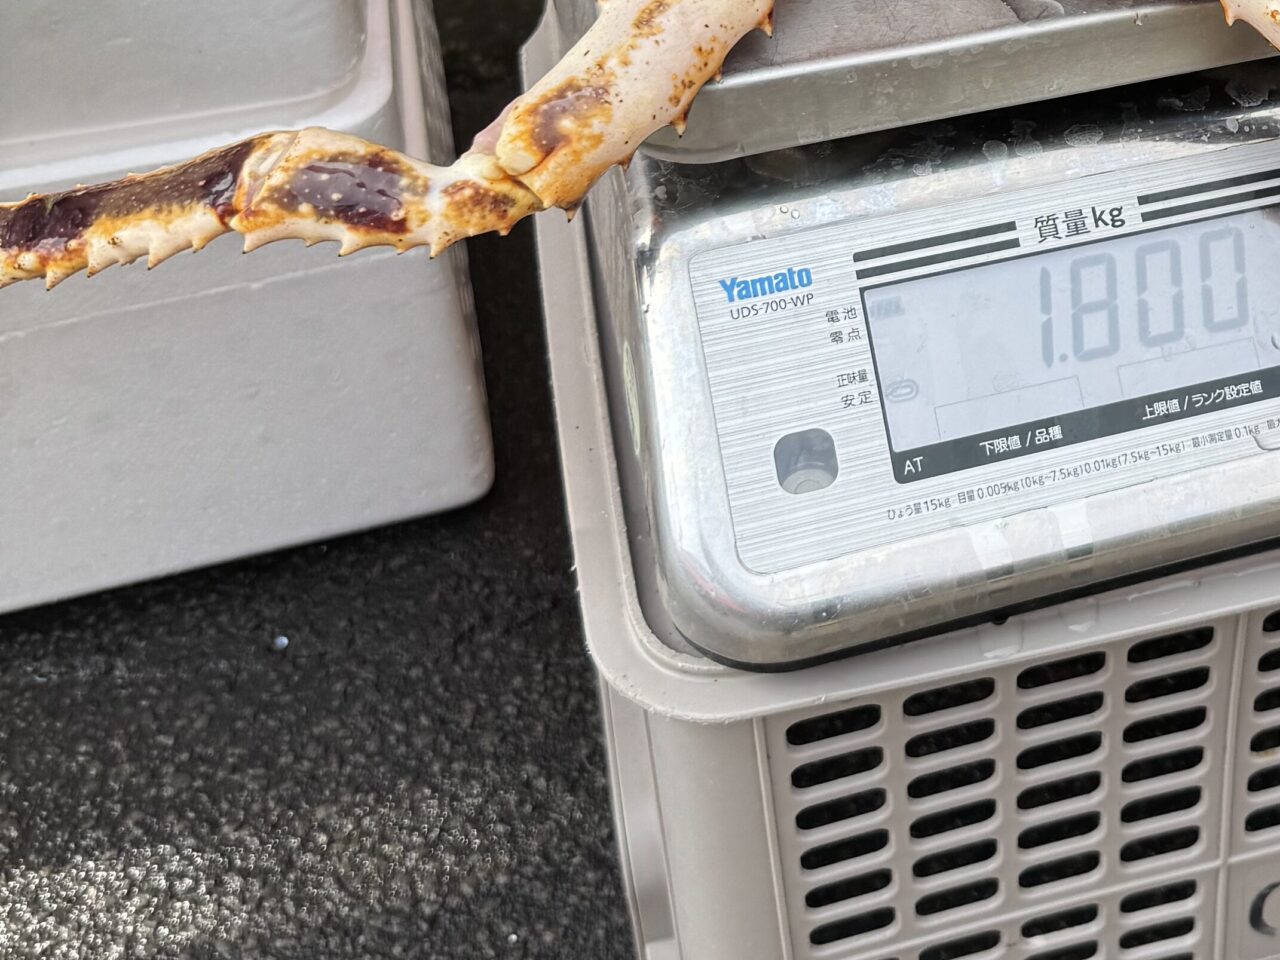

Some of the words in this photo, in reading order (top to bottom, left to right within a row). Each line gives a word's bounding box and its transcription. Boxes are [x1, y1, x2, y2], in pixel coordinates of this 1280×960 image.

[1034, 205, 1126, 243] 質量kg
[719, 267, 813, 303] Yamato
[730, 293, 814, 320] UDS-700-WP
[1040, 226, 1249, 369] 1.800
[826, 306, 858, 323] 電池
[830, 328, 861, 344] 零点
[837, 369, 869, 388] 正味量
[841, 390, 873, 409] 安定
[904, 456, 924, 476] AT
